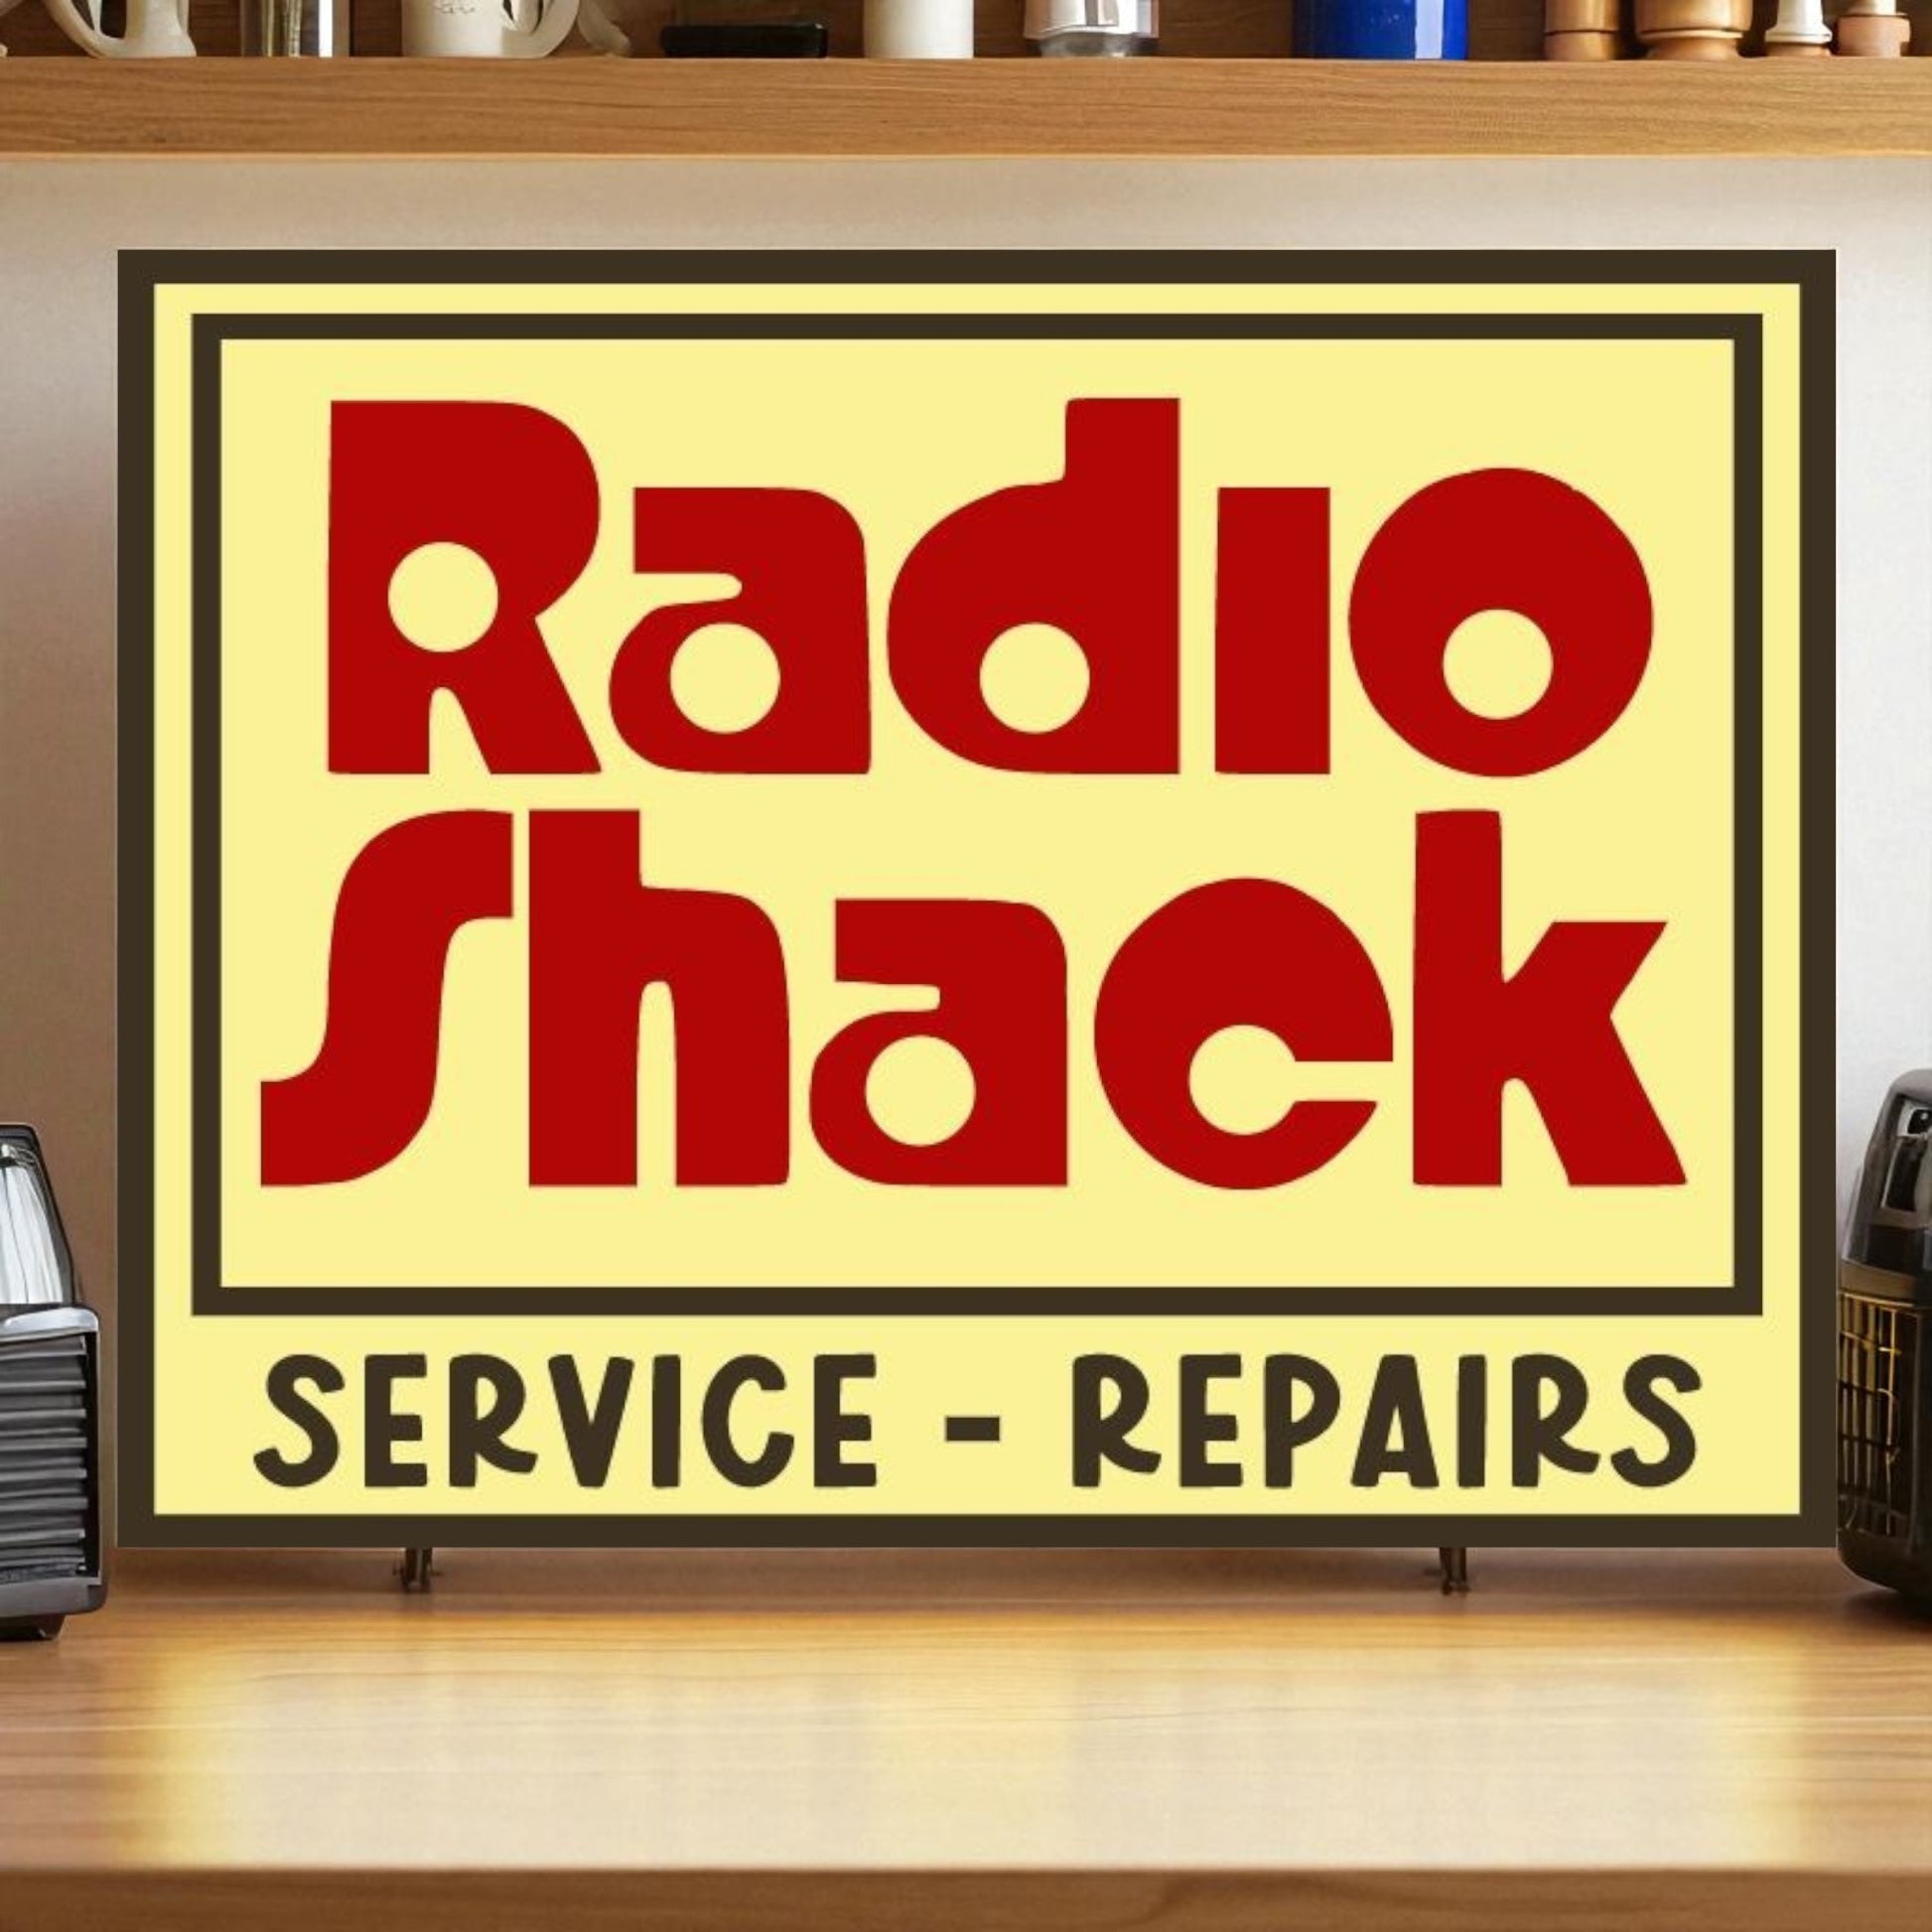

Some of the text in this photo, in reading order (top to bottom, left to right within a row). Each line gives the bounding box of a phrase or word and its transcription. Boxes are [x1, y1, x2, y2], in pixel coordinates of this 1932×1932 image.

[328, 397, 1653, 777] Radio
[260, 809, 1687, 1190] Shack
[253, 1353, 878, 1489] SERVICE
[1072, 1353, 1702, 1489] REPAIRS
